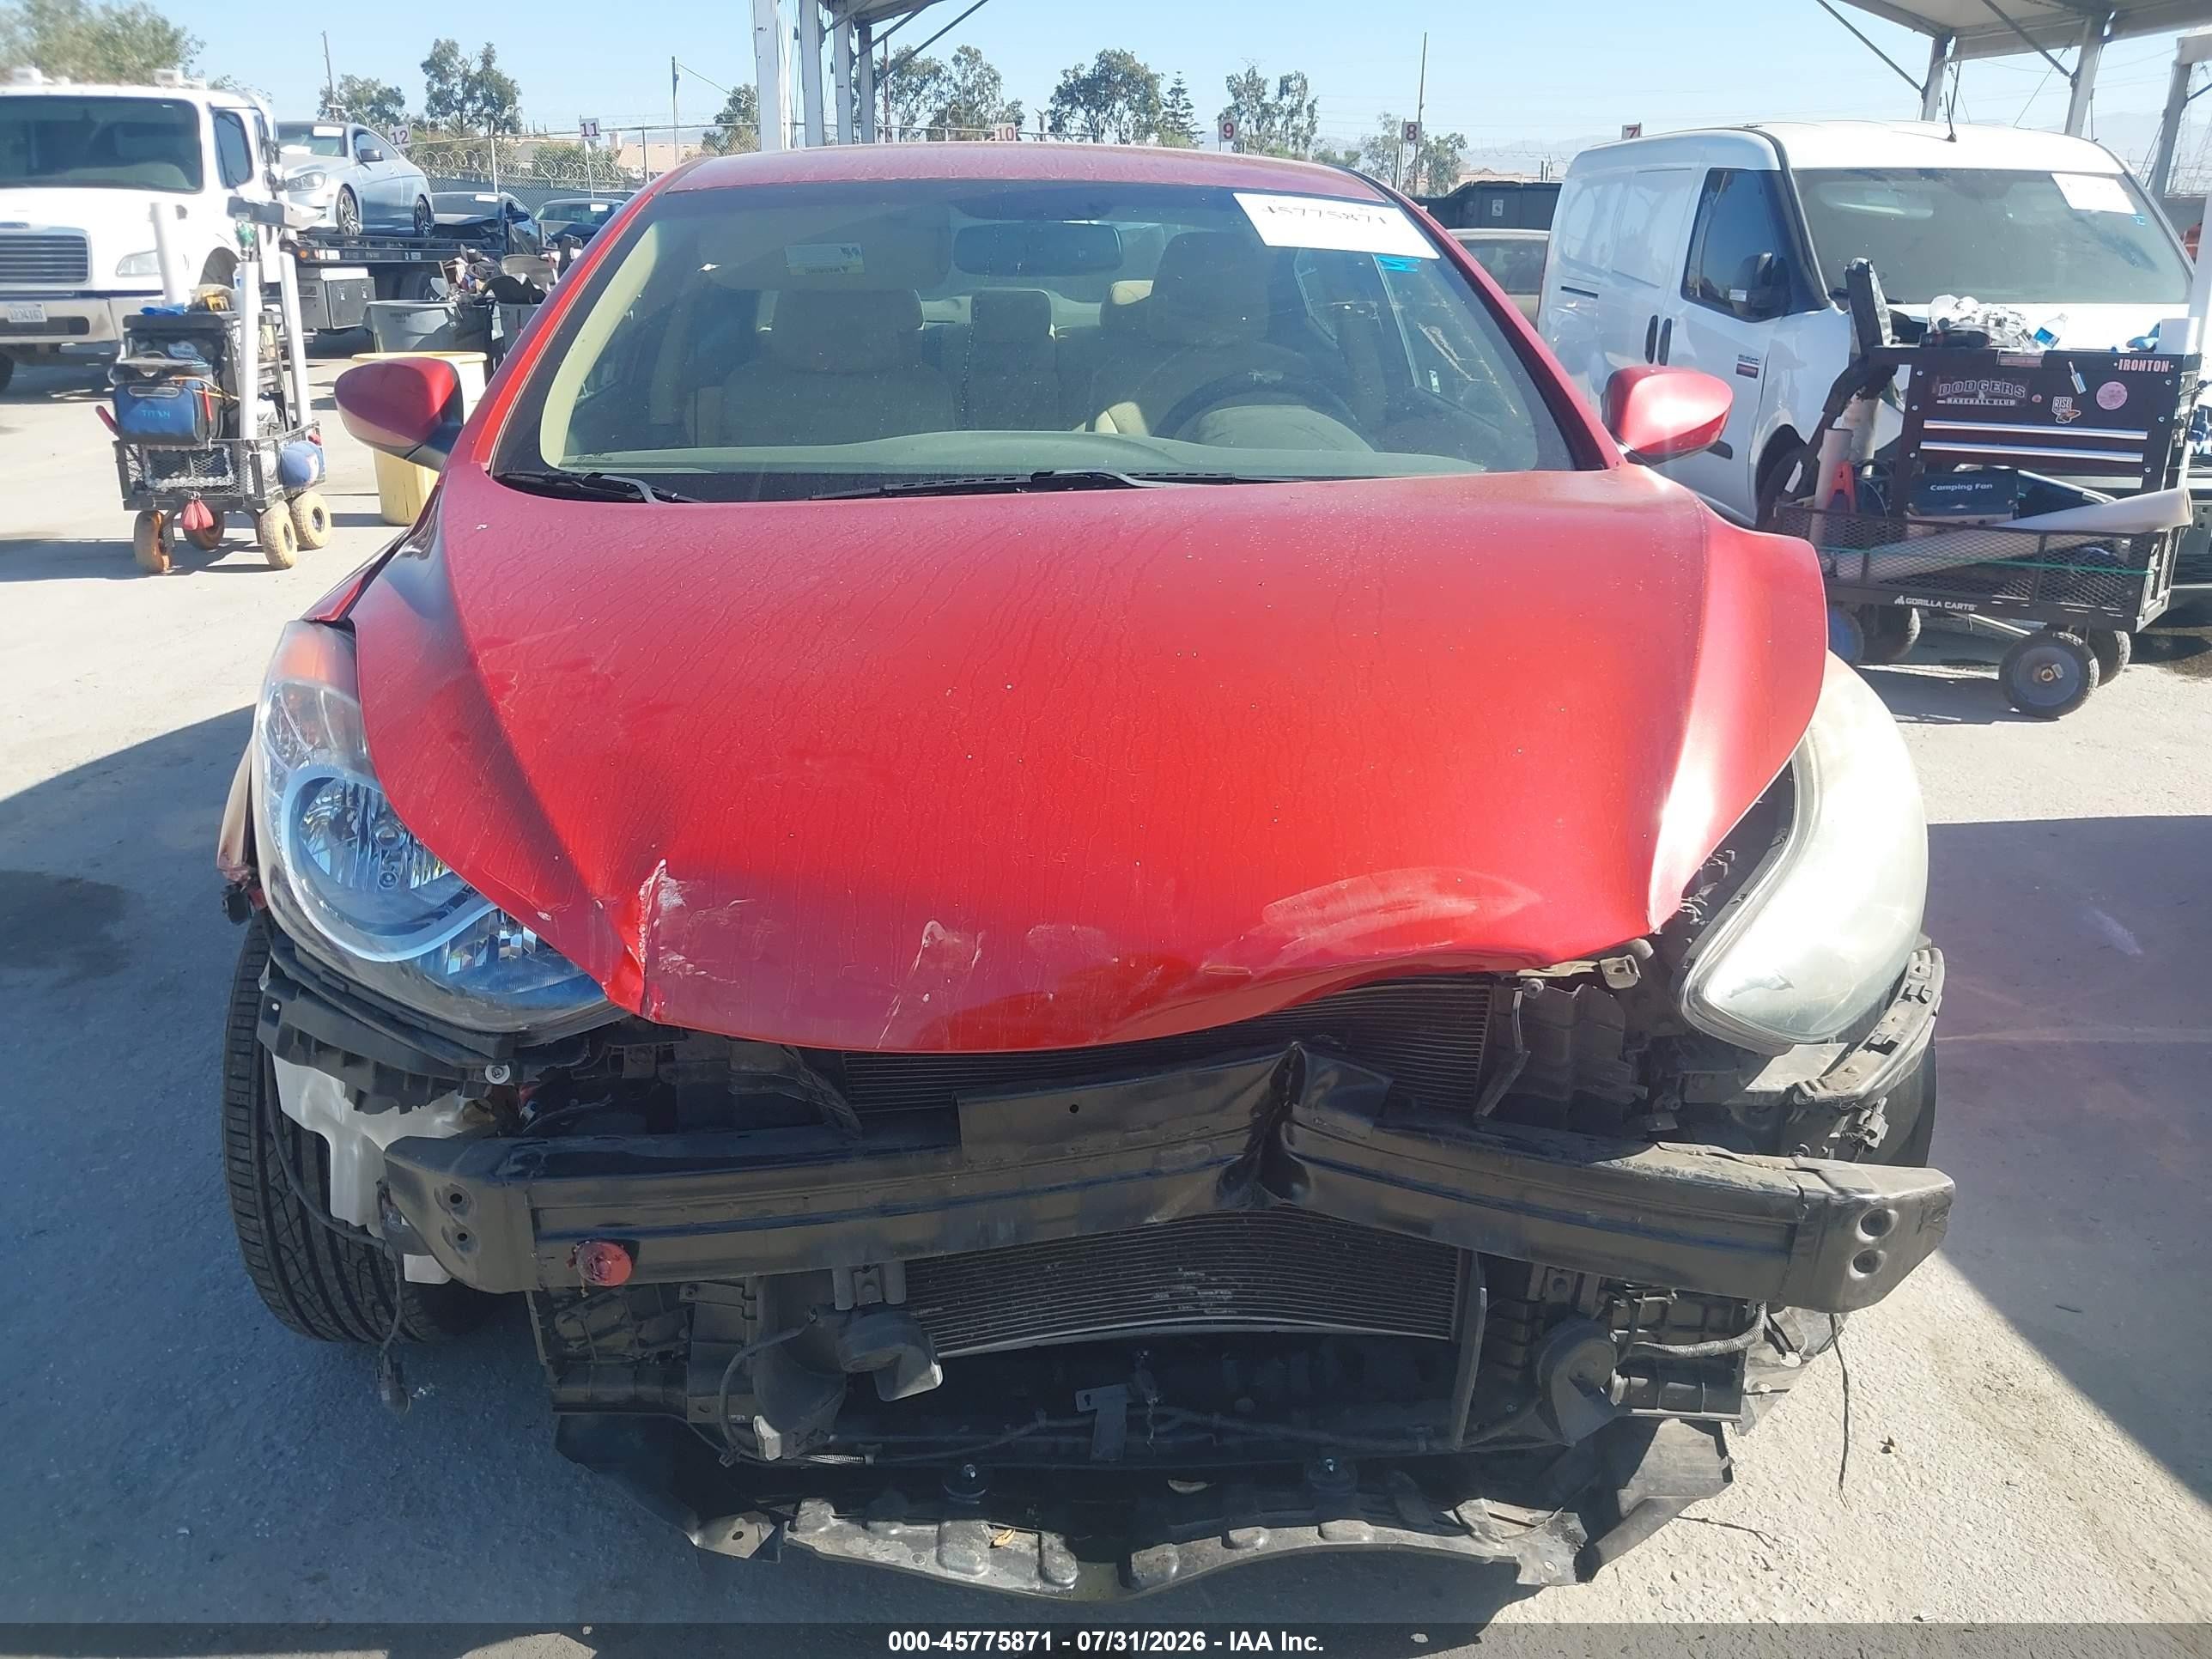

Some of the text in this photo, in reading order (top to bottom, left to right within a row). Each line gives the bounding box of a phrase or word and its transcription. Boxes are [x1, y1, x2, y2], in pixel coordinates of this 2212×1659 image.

[580, 122, 600, 137] 11
[996, 126, 1015, 142] 10
[1223, 122, 1235, 140] 9
[1406, 124, 1418, 141] 8
[1626, 126, 1638, 138] 7
[391, 130, 410, 145] 12
[2118, 358, 2171, 373] IRONTON
[1938, 380, 2027, 398] DODGERS
[2055, 398, 2070, 409] RISE
[1929, 483, 1972, 492] Camping
[1905, 597, 1975, 611] GORILLA CARTS
